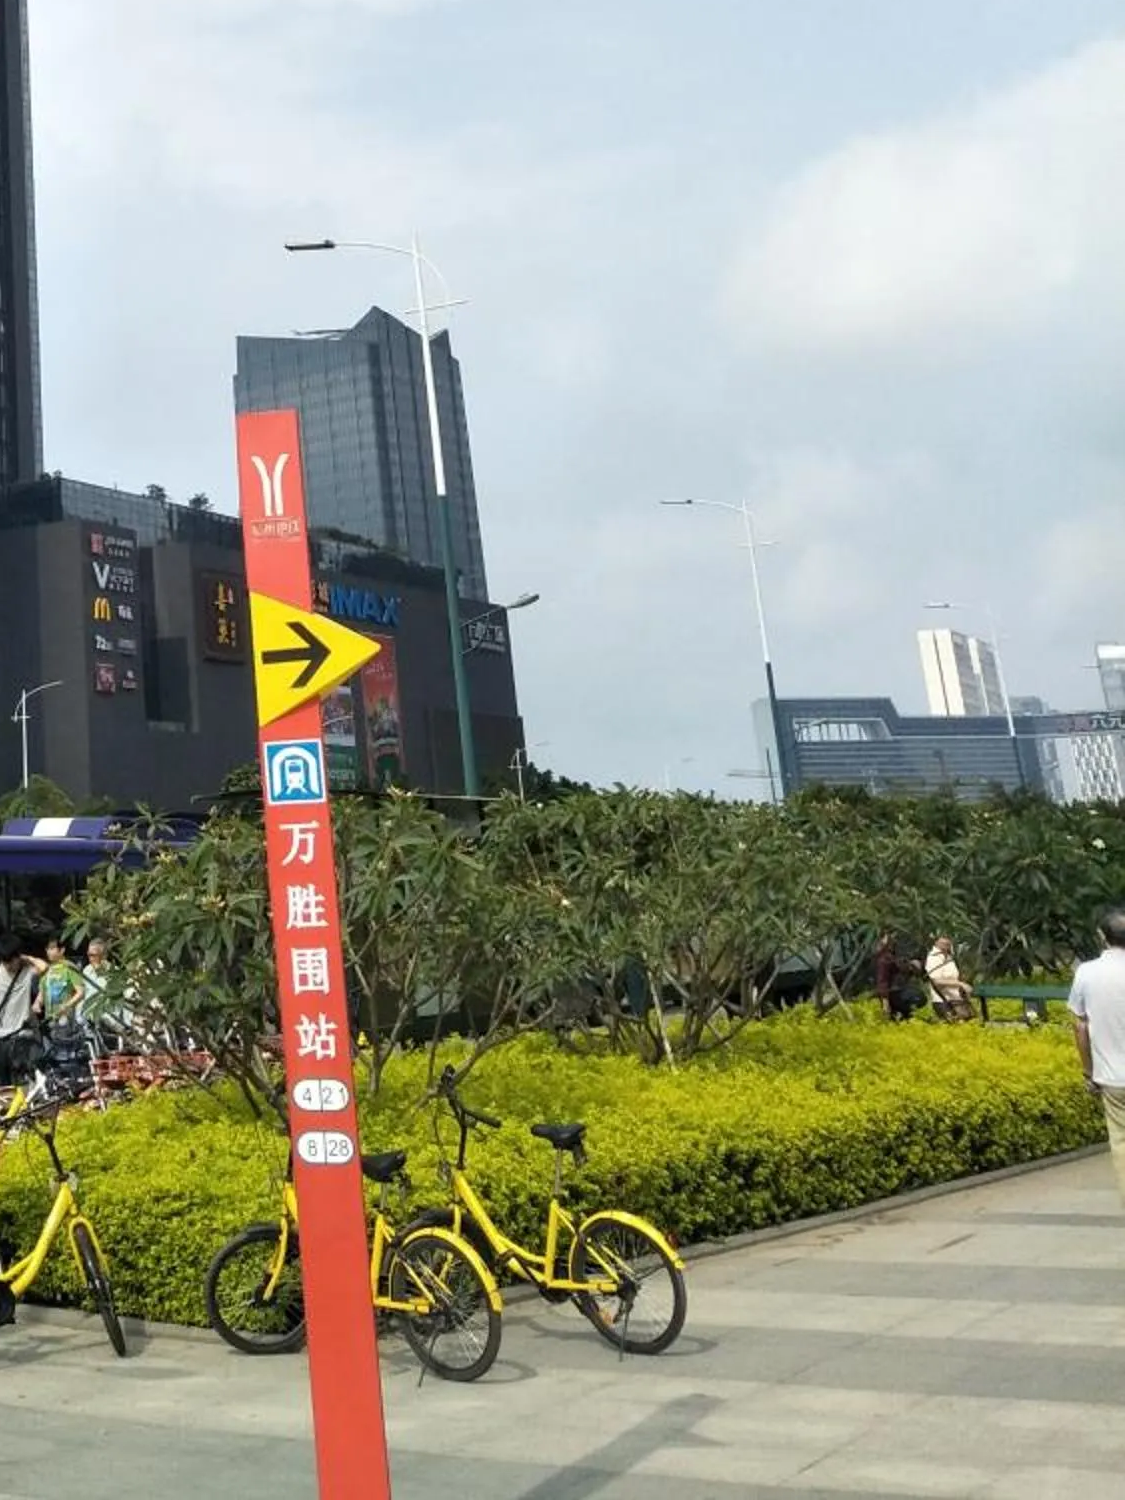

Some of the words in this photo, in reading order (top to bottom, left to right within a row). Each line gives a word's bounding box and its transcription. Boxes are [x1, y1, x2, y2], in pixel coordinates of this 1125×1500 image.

[330, 584, 401, 627] IMAX
[279, 820, 338, 1061] 万胜围站
[328, 1139, 350, 1157] 28
